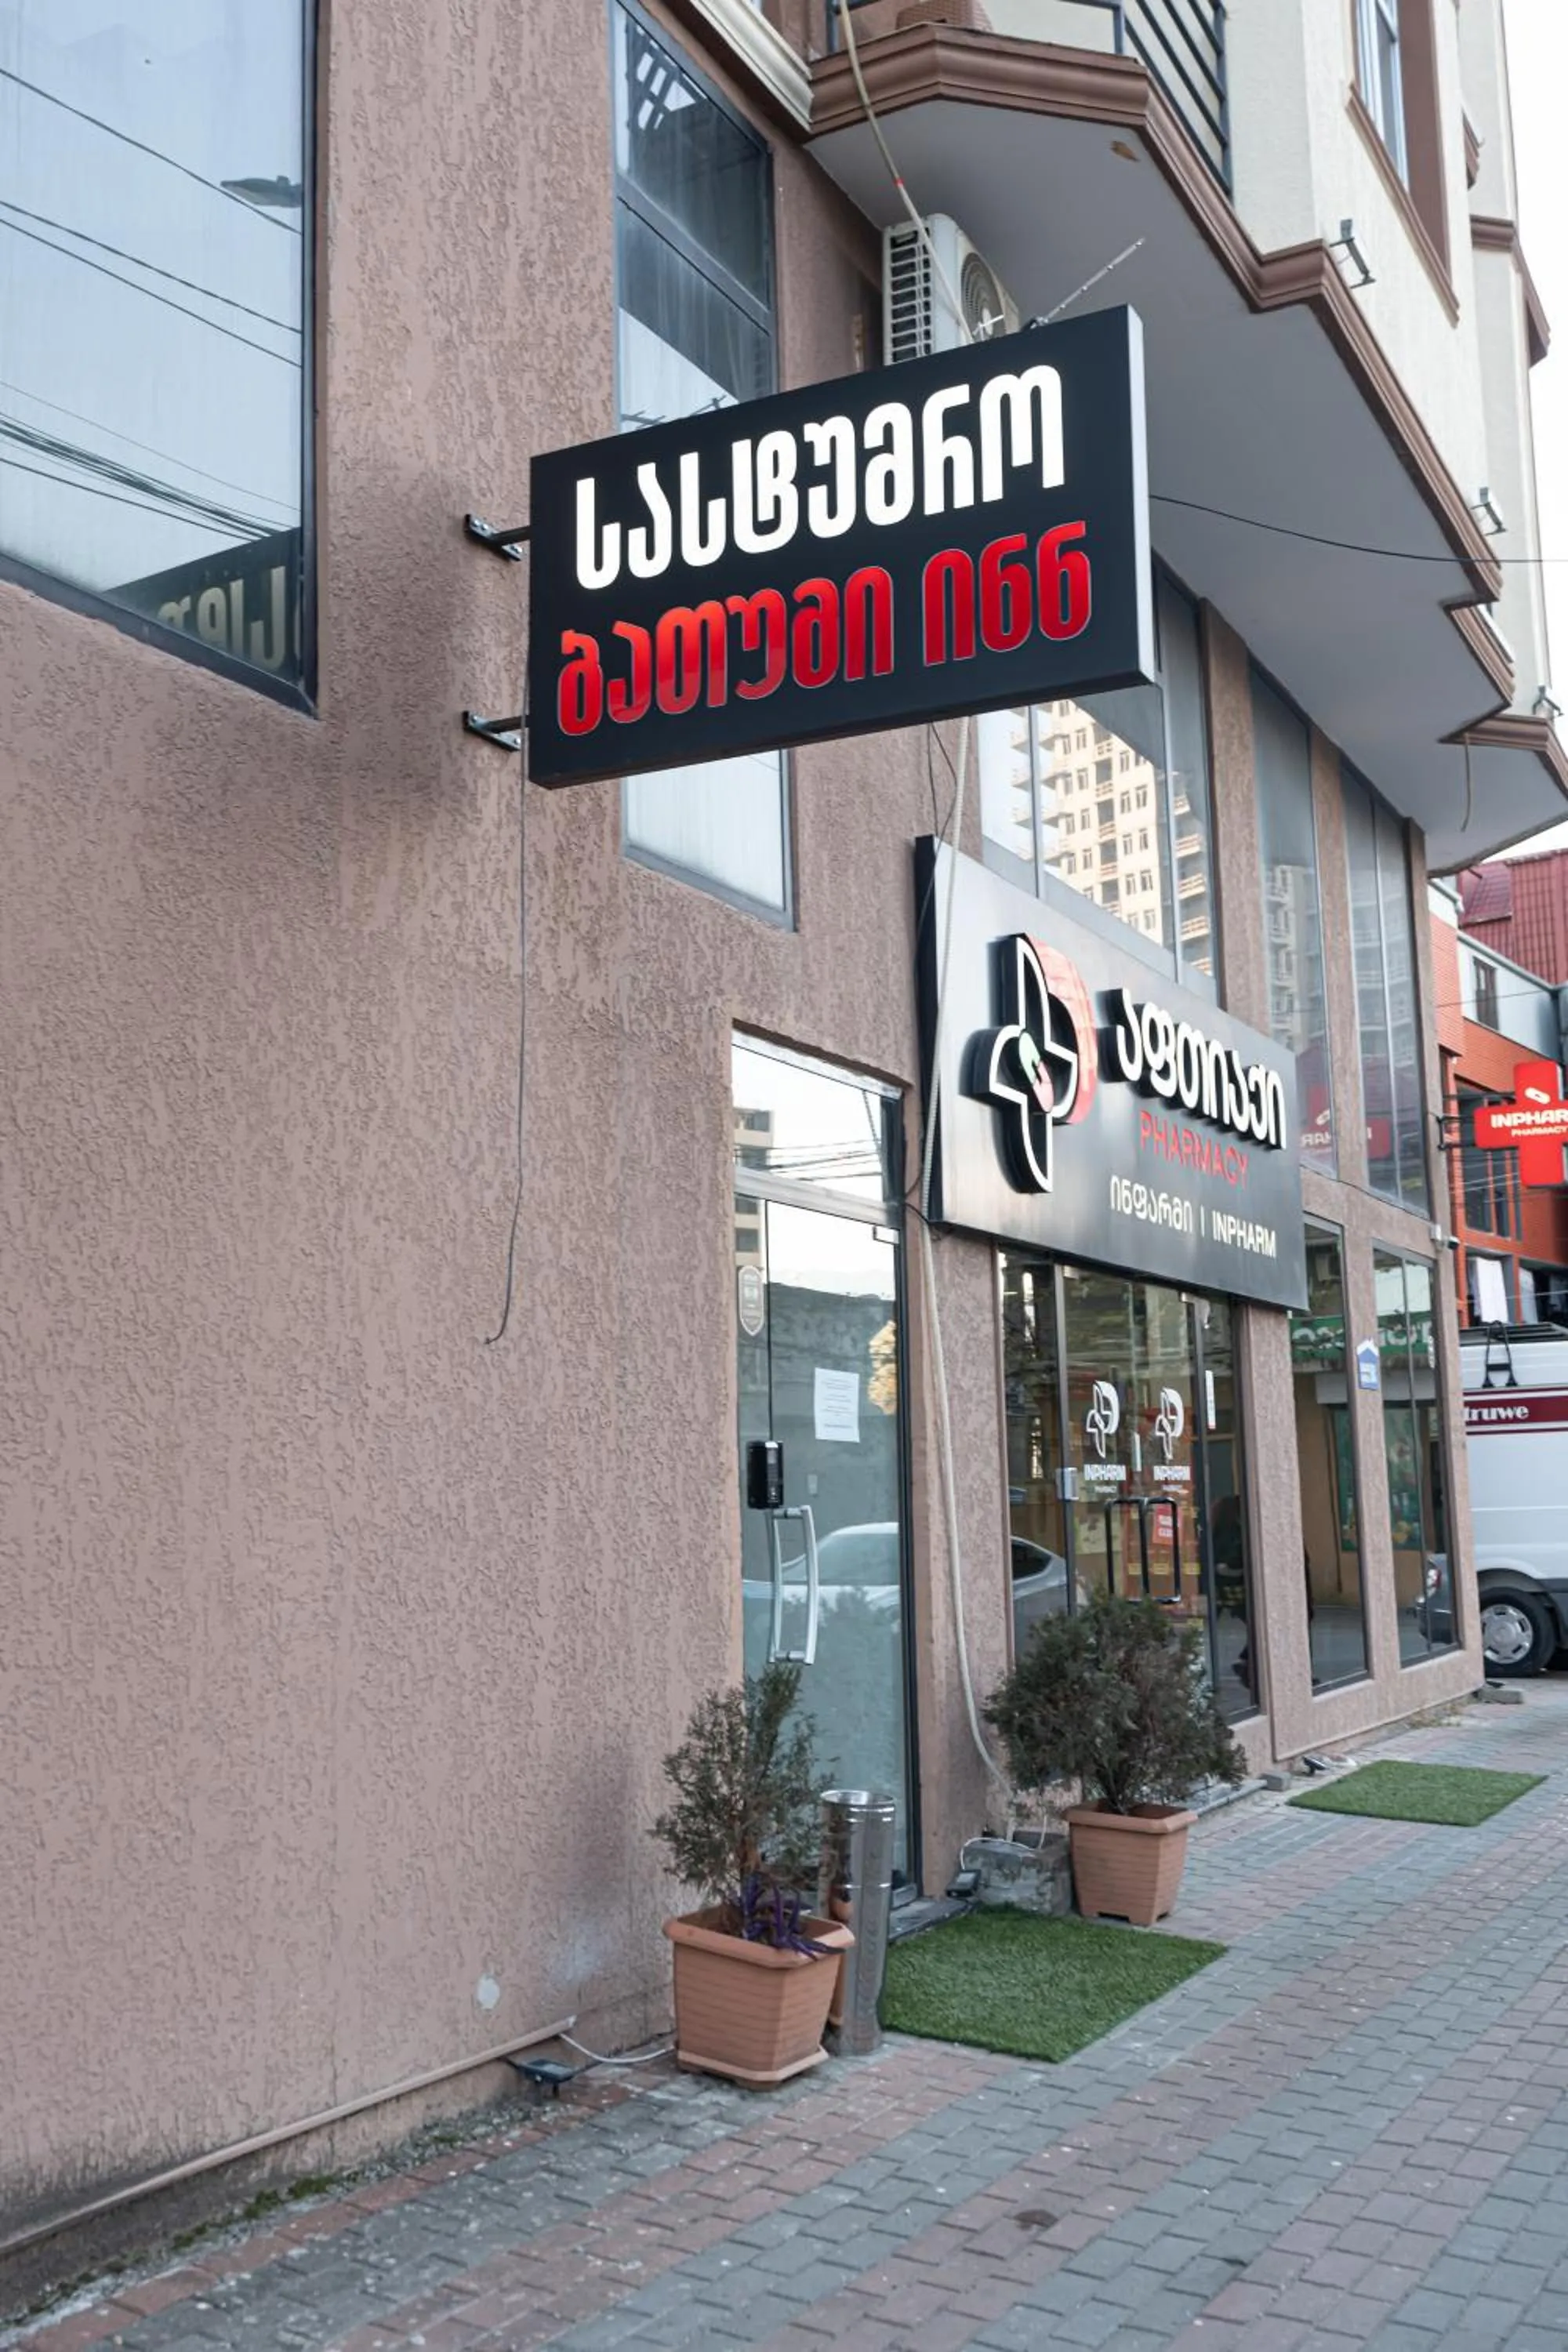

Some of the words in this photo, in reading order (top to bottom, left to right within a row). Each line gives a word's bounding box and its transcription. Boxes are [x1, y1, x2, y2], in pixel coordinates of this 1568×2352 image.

[576, 365, 1065, 590] სასტუმრო
[557, 566, 894, 735] ბათუმი
[923, 521, 1091, 666] ინნ
[1116, 988, 1287, 1150] აფთიაქი
[1110, 1175, 1192, 1233] ინფარმი
[1140, 1110, 1249, 1188] PHARMACY
[1212, 1210, 1277, 1258] INPHARM
